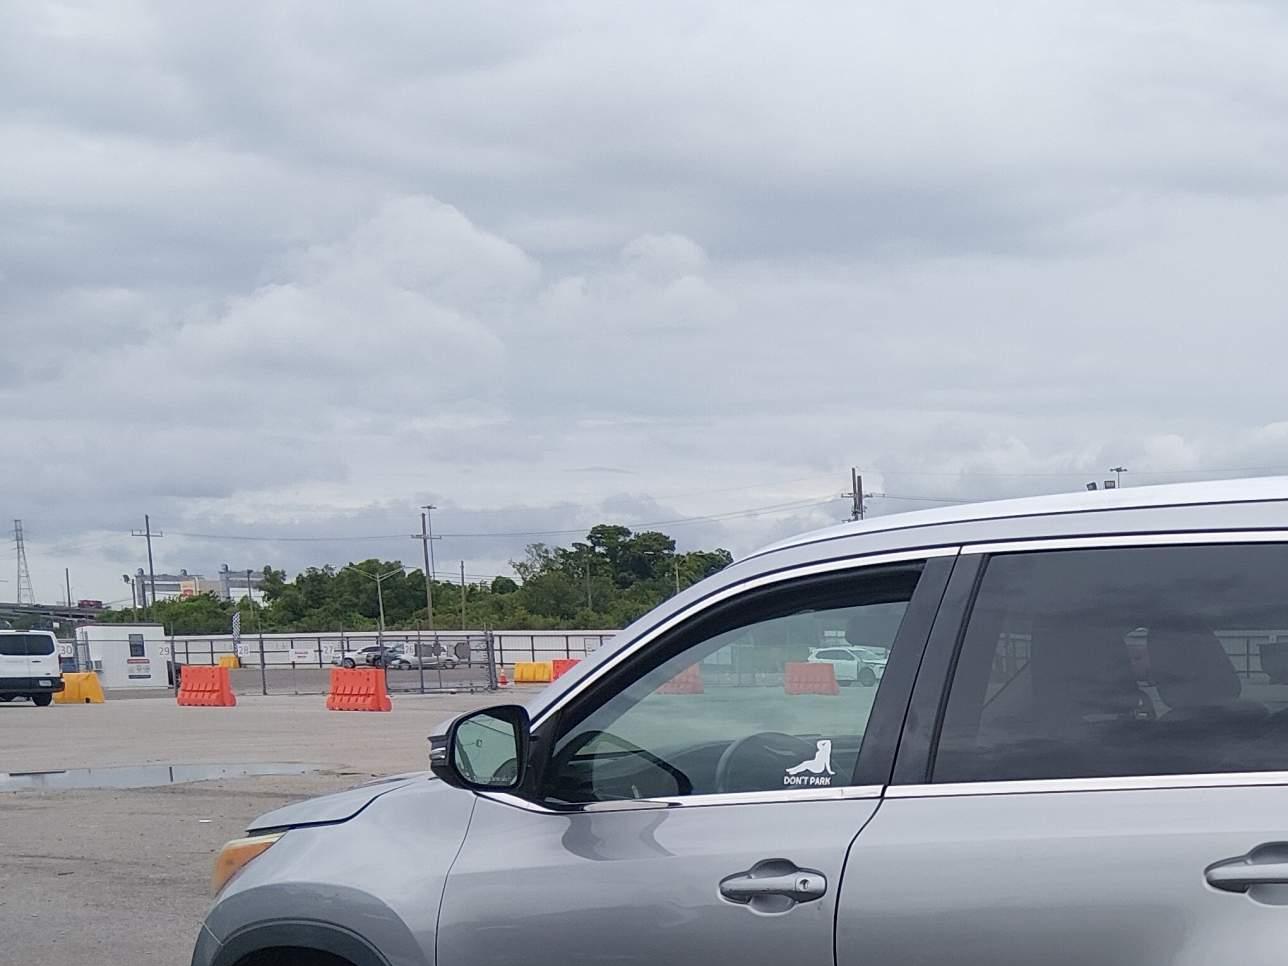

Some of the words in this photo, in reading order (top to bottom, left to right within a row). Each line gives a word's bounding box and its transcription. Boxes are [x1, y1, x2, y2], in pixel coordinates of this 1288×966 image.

[58, 645, 73, 655] 30
[159, 646, 170, 656] 29
[783, 776, 808, 785] DON'T
[809, 776, 832, 786] PARK
